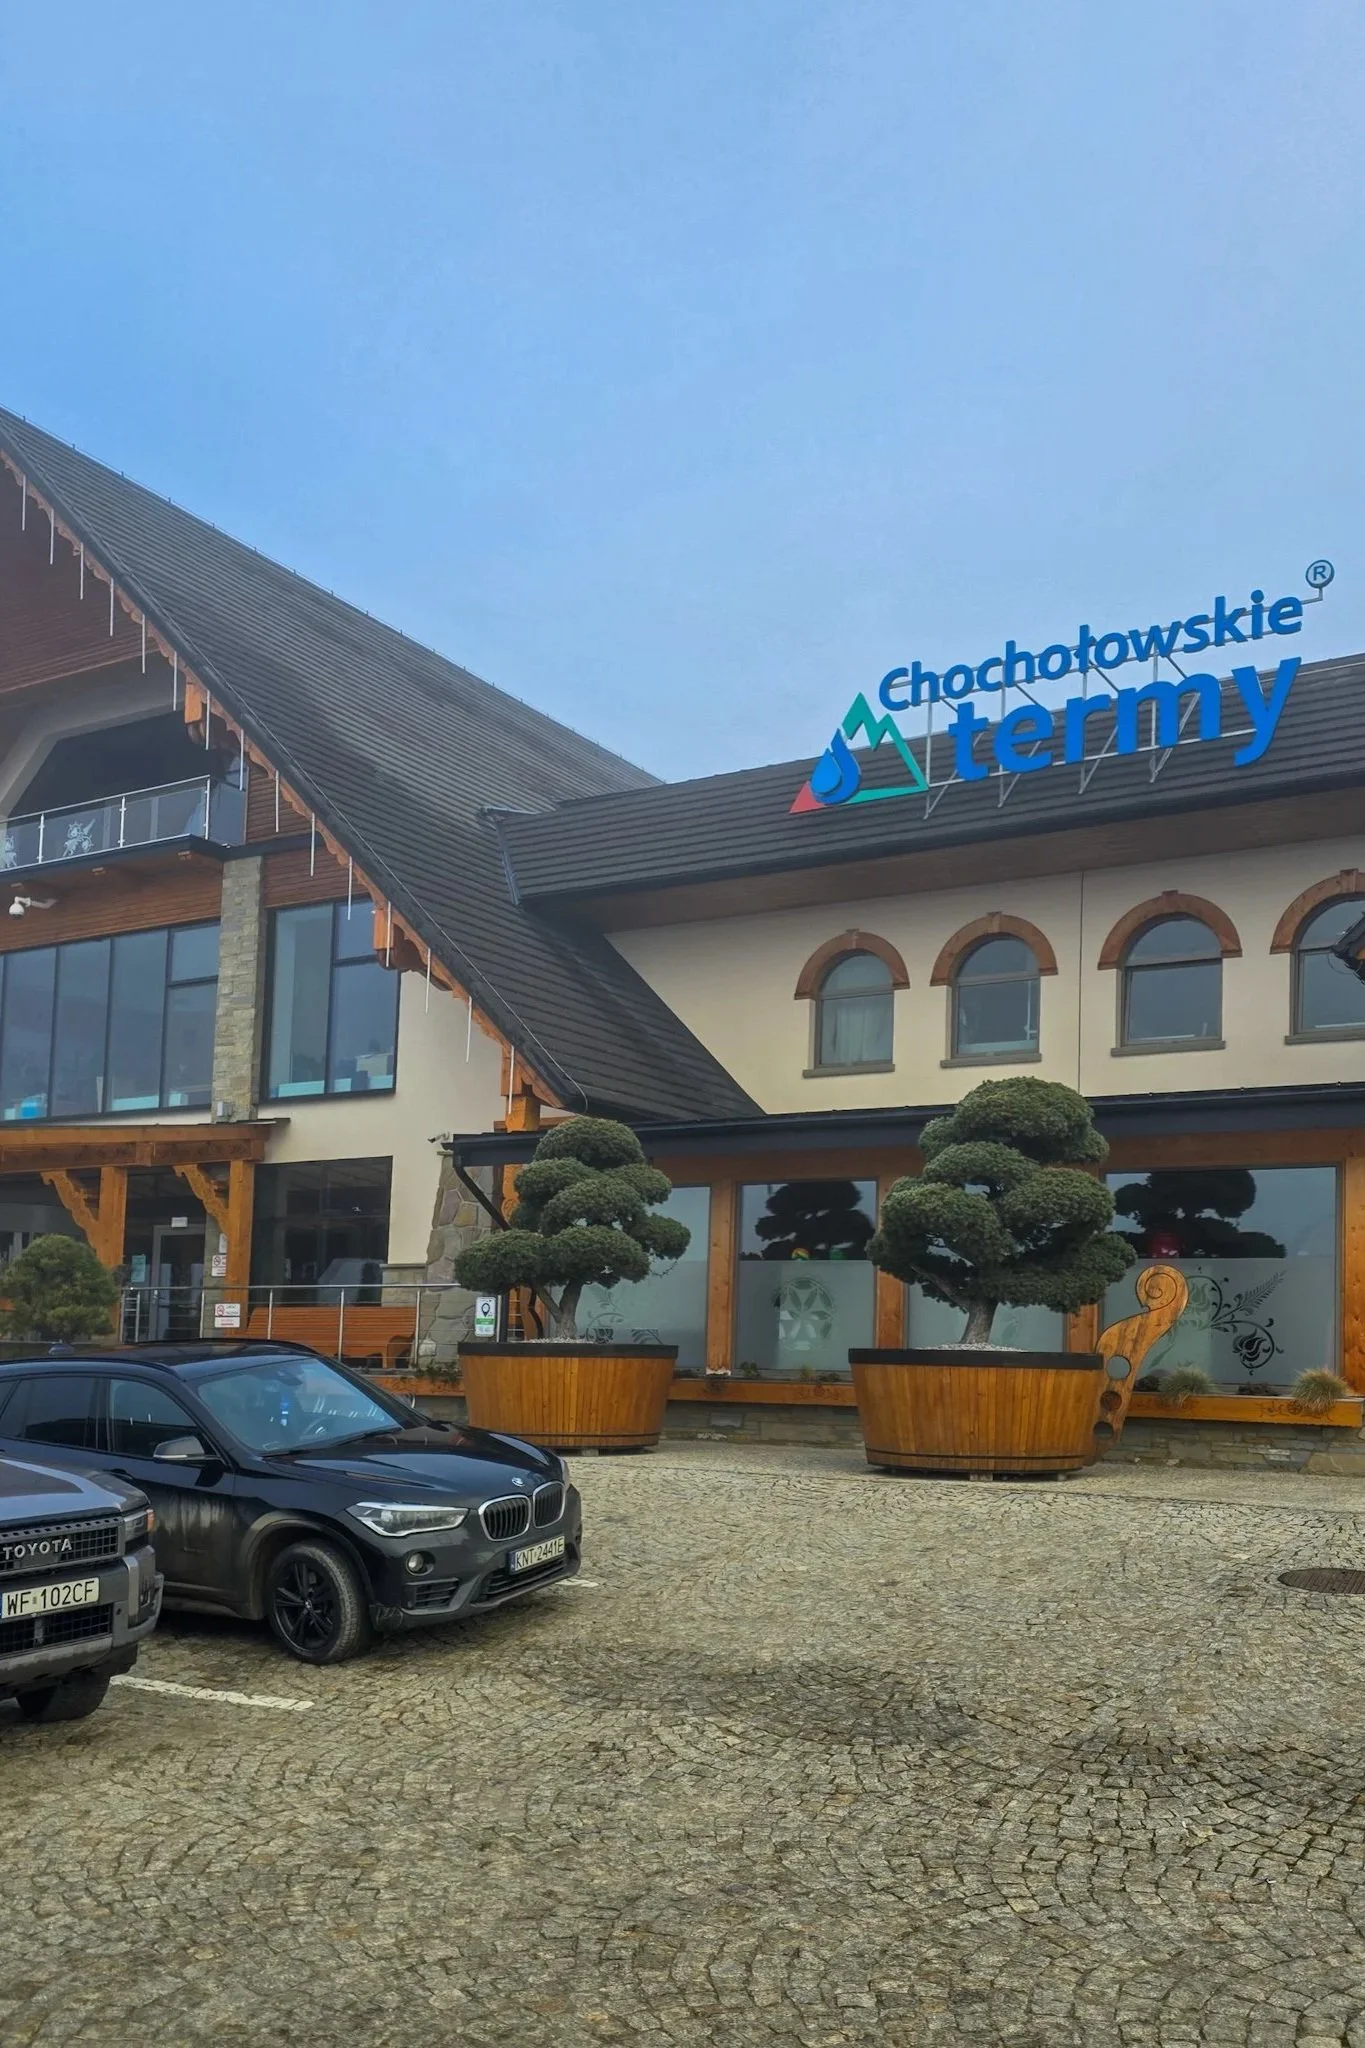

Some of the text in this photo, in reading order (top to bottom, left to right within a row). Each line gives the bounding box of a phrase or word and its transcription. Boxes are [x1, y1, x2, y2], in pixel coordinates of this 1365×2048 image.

[949, 656, 1302, 782] termy
[2, 1538, 72, 1560] TOYOTA
[516, 1537, 563, 1569] KNT 2441E
[7, 1580, 95, 1615] WF 102CF
